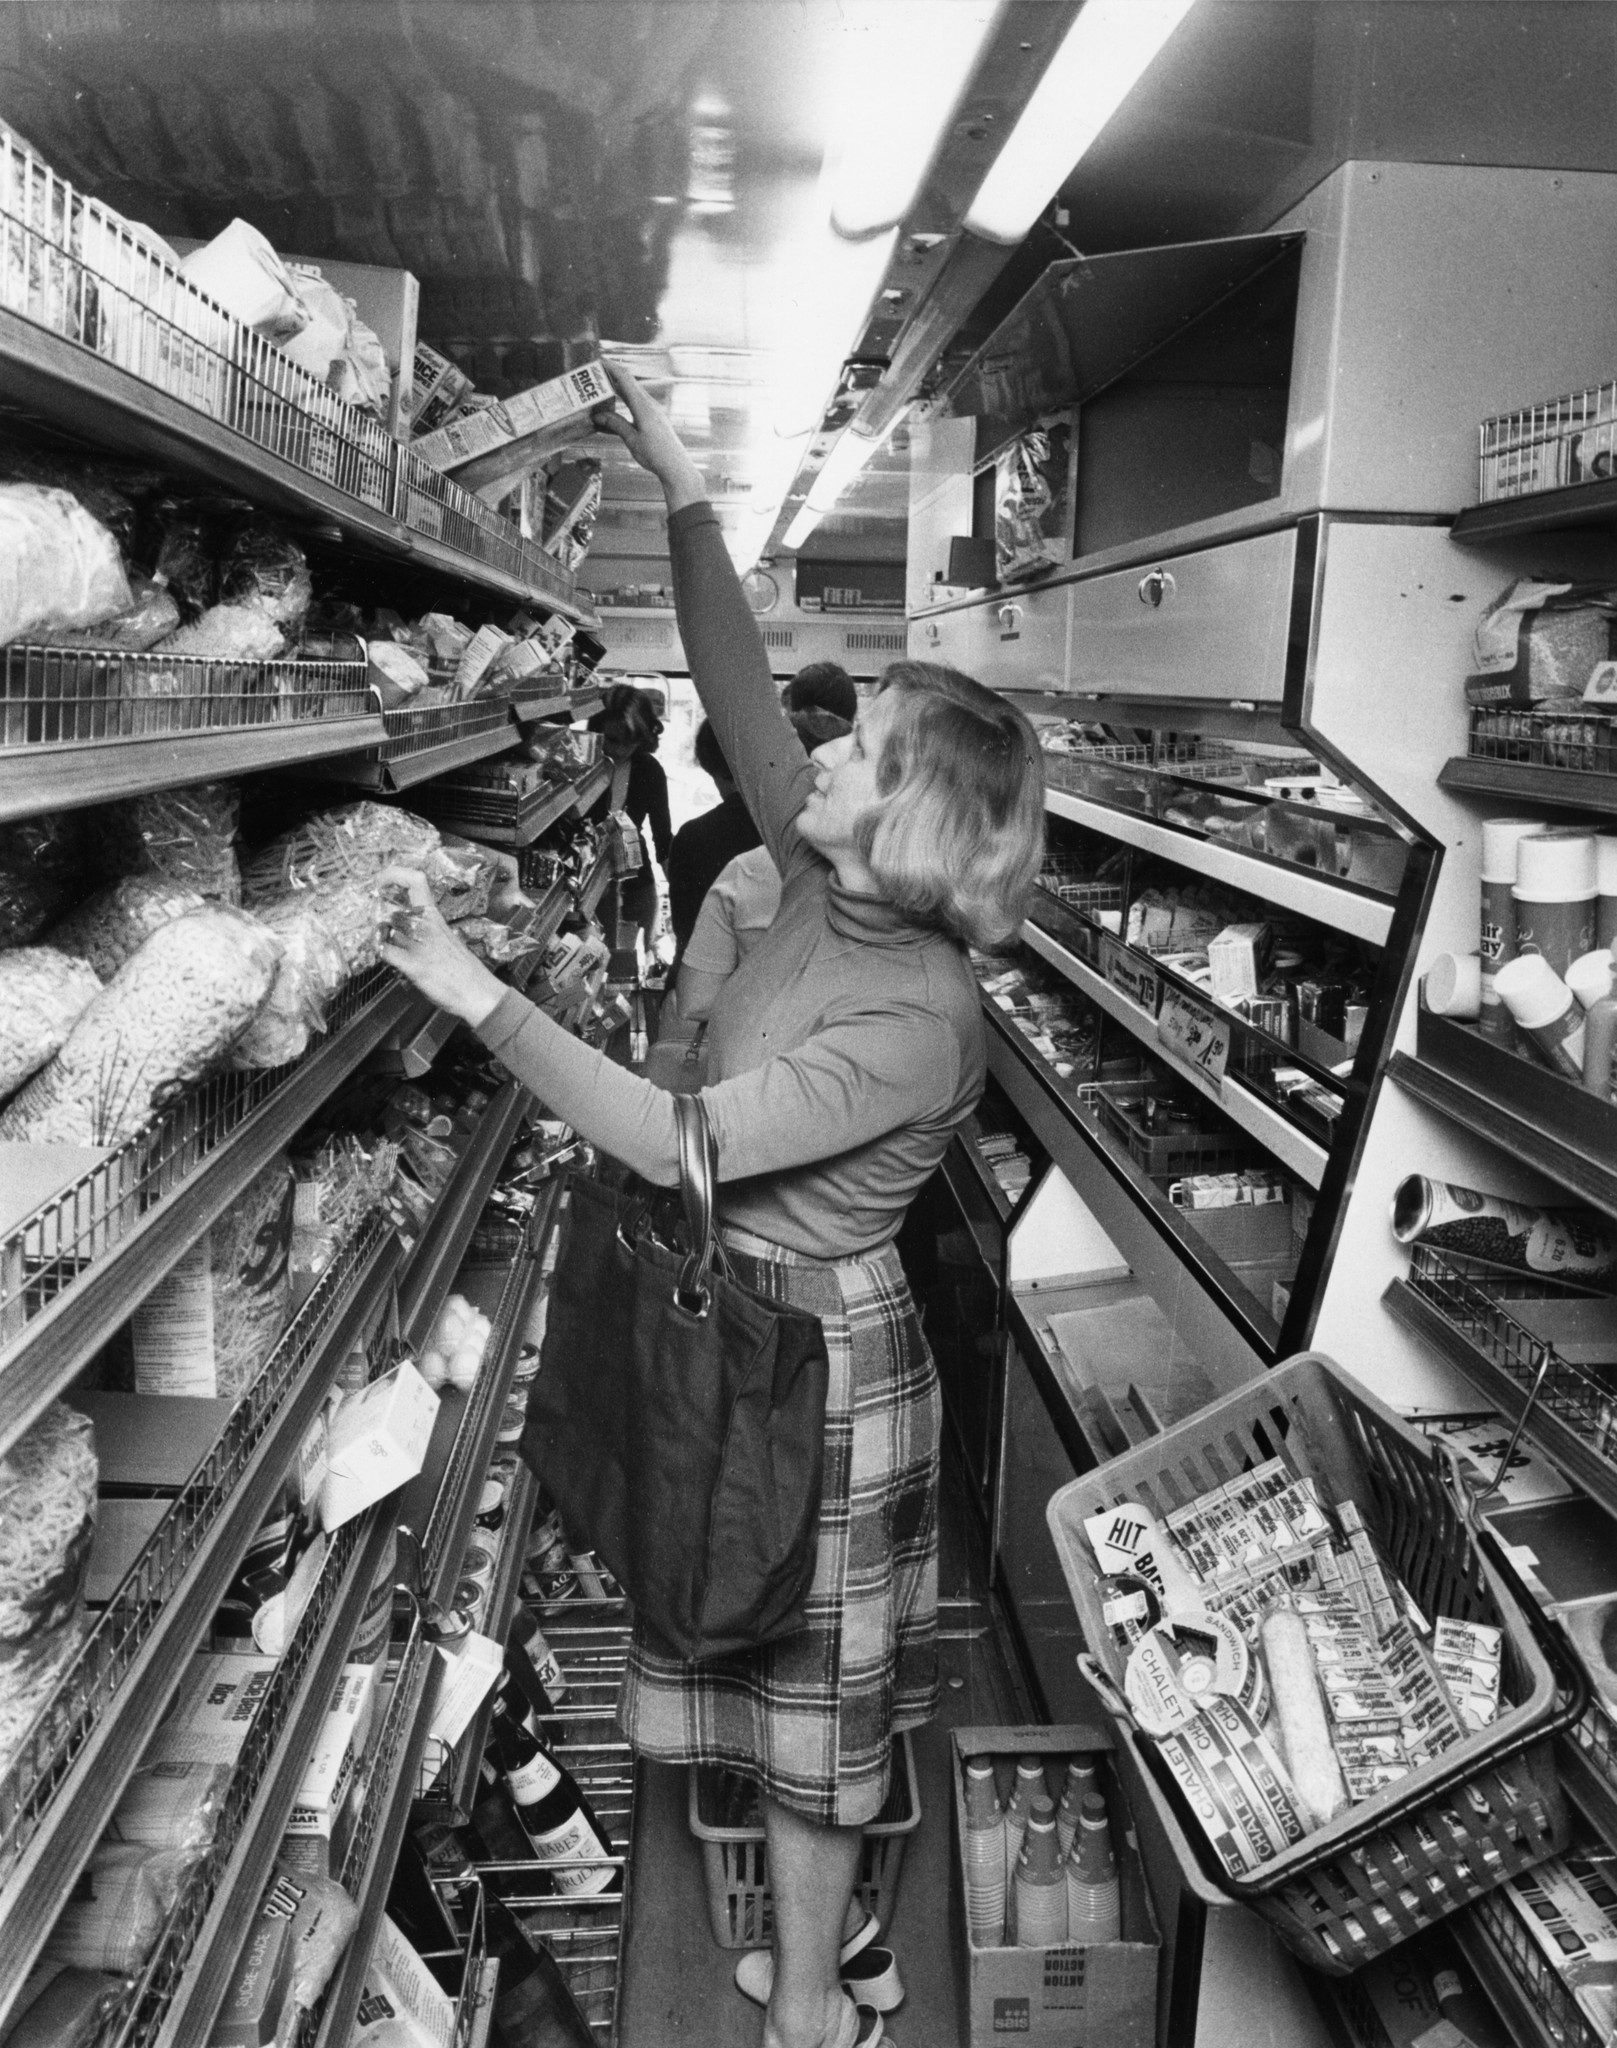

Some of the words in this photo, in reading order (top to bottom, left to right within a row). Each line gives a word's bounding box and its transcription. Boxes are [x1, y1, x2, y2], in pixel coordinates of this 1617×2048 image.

[577, 369, 599, 401] RICE
[1551, 1238, 1567, 1262] 6.20
[1107, 1517, 1147, 1550] HIT
[1238, 1528, 1251, 1545] 2.20
[1204, 1615, 1242, 1672] SANDWICH
[1343, 1650, 1362, 1658] 2.20
[207, 1684, 237, 1704] Rice
[244, 1671, 273, 1696] Uncle
[1141, 1648, 1185, 1720] CHALET
[1396, 1669, 1430, 1696] Bouillon
[1411, 1675, 1435, 1696] poule
[1402, 1692, 1415, 1705] de
[1409, 1696, 1443, 1723] Bouillon
[1215, 1701, 1240, 1732] CHA
[1414, 1719, 1428, 1732] de
[1423, 1703, 1449, 1725] poule
[1187, 1721, 1211, 1750] CHA
[1422, 1722, 1456, 1750] Bouillon
[1437, 1730, 1463, 1753] poule
[1428, 1747, 1441, 1760] de
[1164, 1746, 1216, 1819] CHALET
[1254, 1763, 1300, 1838] CHALET
[288, 1815, 318, 1823] GAR
[1226, 1782, 1272, 1857] CHALET
[1044, 1960, 1084, 1971] ACTION
[1044, 1975, 1084, 1986] AKTION
